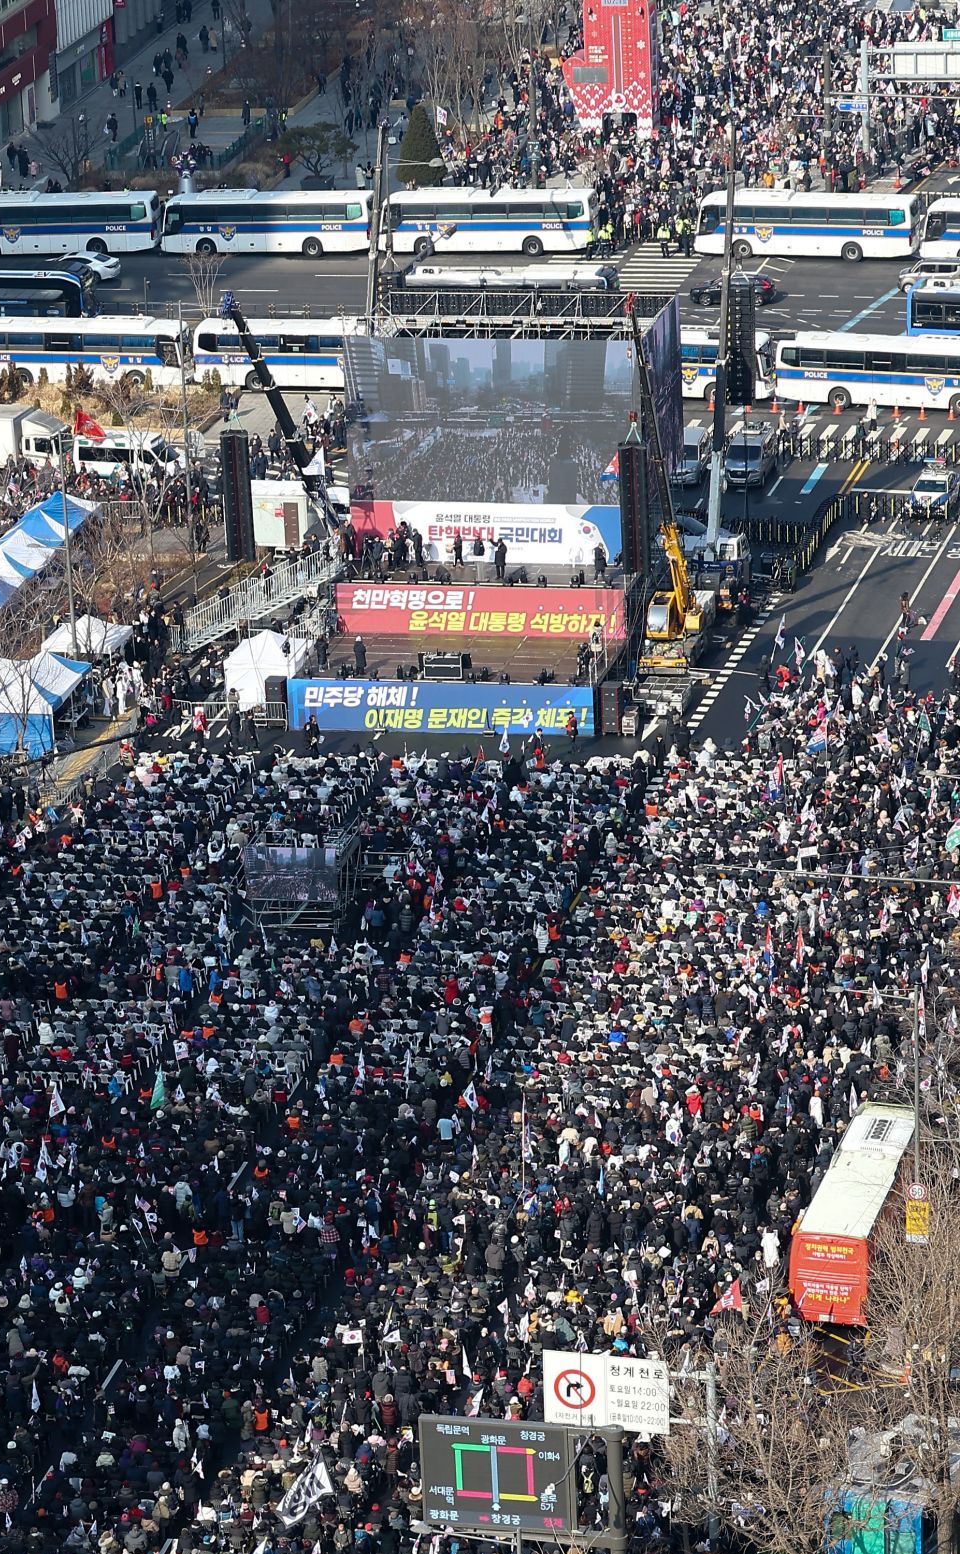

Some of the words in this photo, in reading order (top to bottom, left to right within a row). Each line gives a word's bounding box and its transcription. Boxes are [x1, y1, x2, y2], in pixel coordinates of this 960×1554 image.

[804, 371, 828, 379] POLICE
[435, 514, 462, 523] 윤석열
[463, 514, 491, 524] 대통령
[428, 525, 495, 542] 탄핵반대
[498, 527, 563, 543] 국민대회
[408, 611, 466, 632] 윤석열
[469, 612, 526, 633] 대통령
[304, 686, 364, 708] 민주당
[364, 708, 424, 729] 이재명
[428, 708, 487, 729] 문재인
[491, 708, 531, 729] 즉각
[640, 1401, 666, 1412] 22:00
[436, 1424, 470, 1436] 독립문역
[520, 1430, 546, 1442] 창경궁
[480, 1434, 507, 1446] 광화문
[538, 1451, 561, 1462] 이화4
[428, 1485, 455, 1498] 서대문
[445, 1495, 455, 1506] 역
[540, 1502, 555, 1513] 5가
[429, 1509, 460, 1522] 광화문
[491, 1514, 521, 1527] 창경궁
